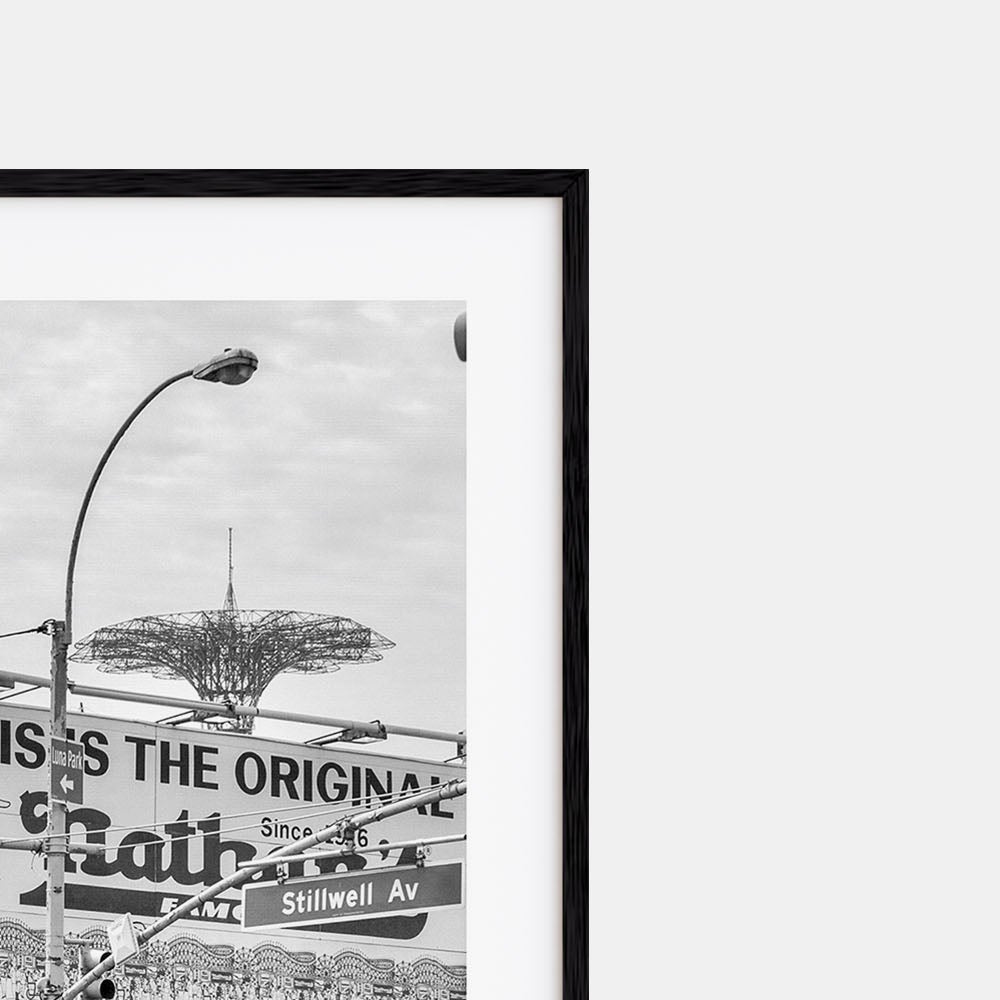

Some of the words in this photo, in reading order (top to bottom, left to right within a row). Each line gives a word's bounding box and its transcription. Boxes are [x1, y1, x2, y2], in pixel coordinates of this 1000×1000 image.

[51, 746, 67, 767] Luna
[67, 750, 83, 770] Park
[125, 735, 219, 791] THE
[234, 751, 454, 819] ORIGINAL
[282, 881, 373, 915] Stillwell
[388, 879, 419, 903] Av
